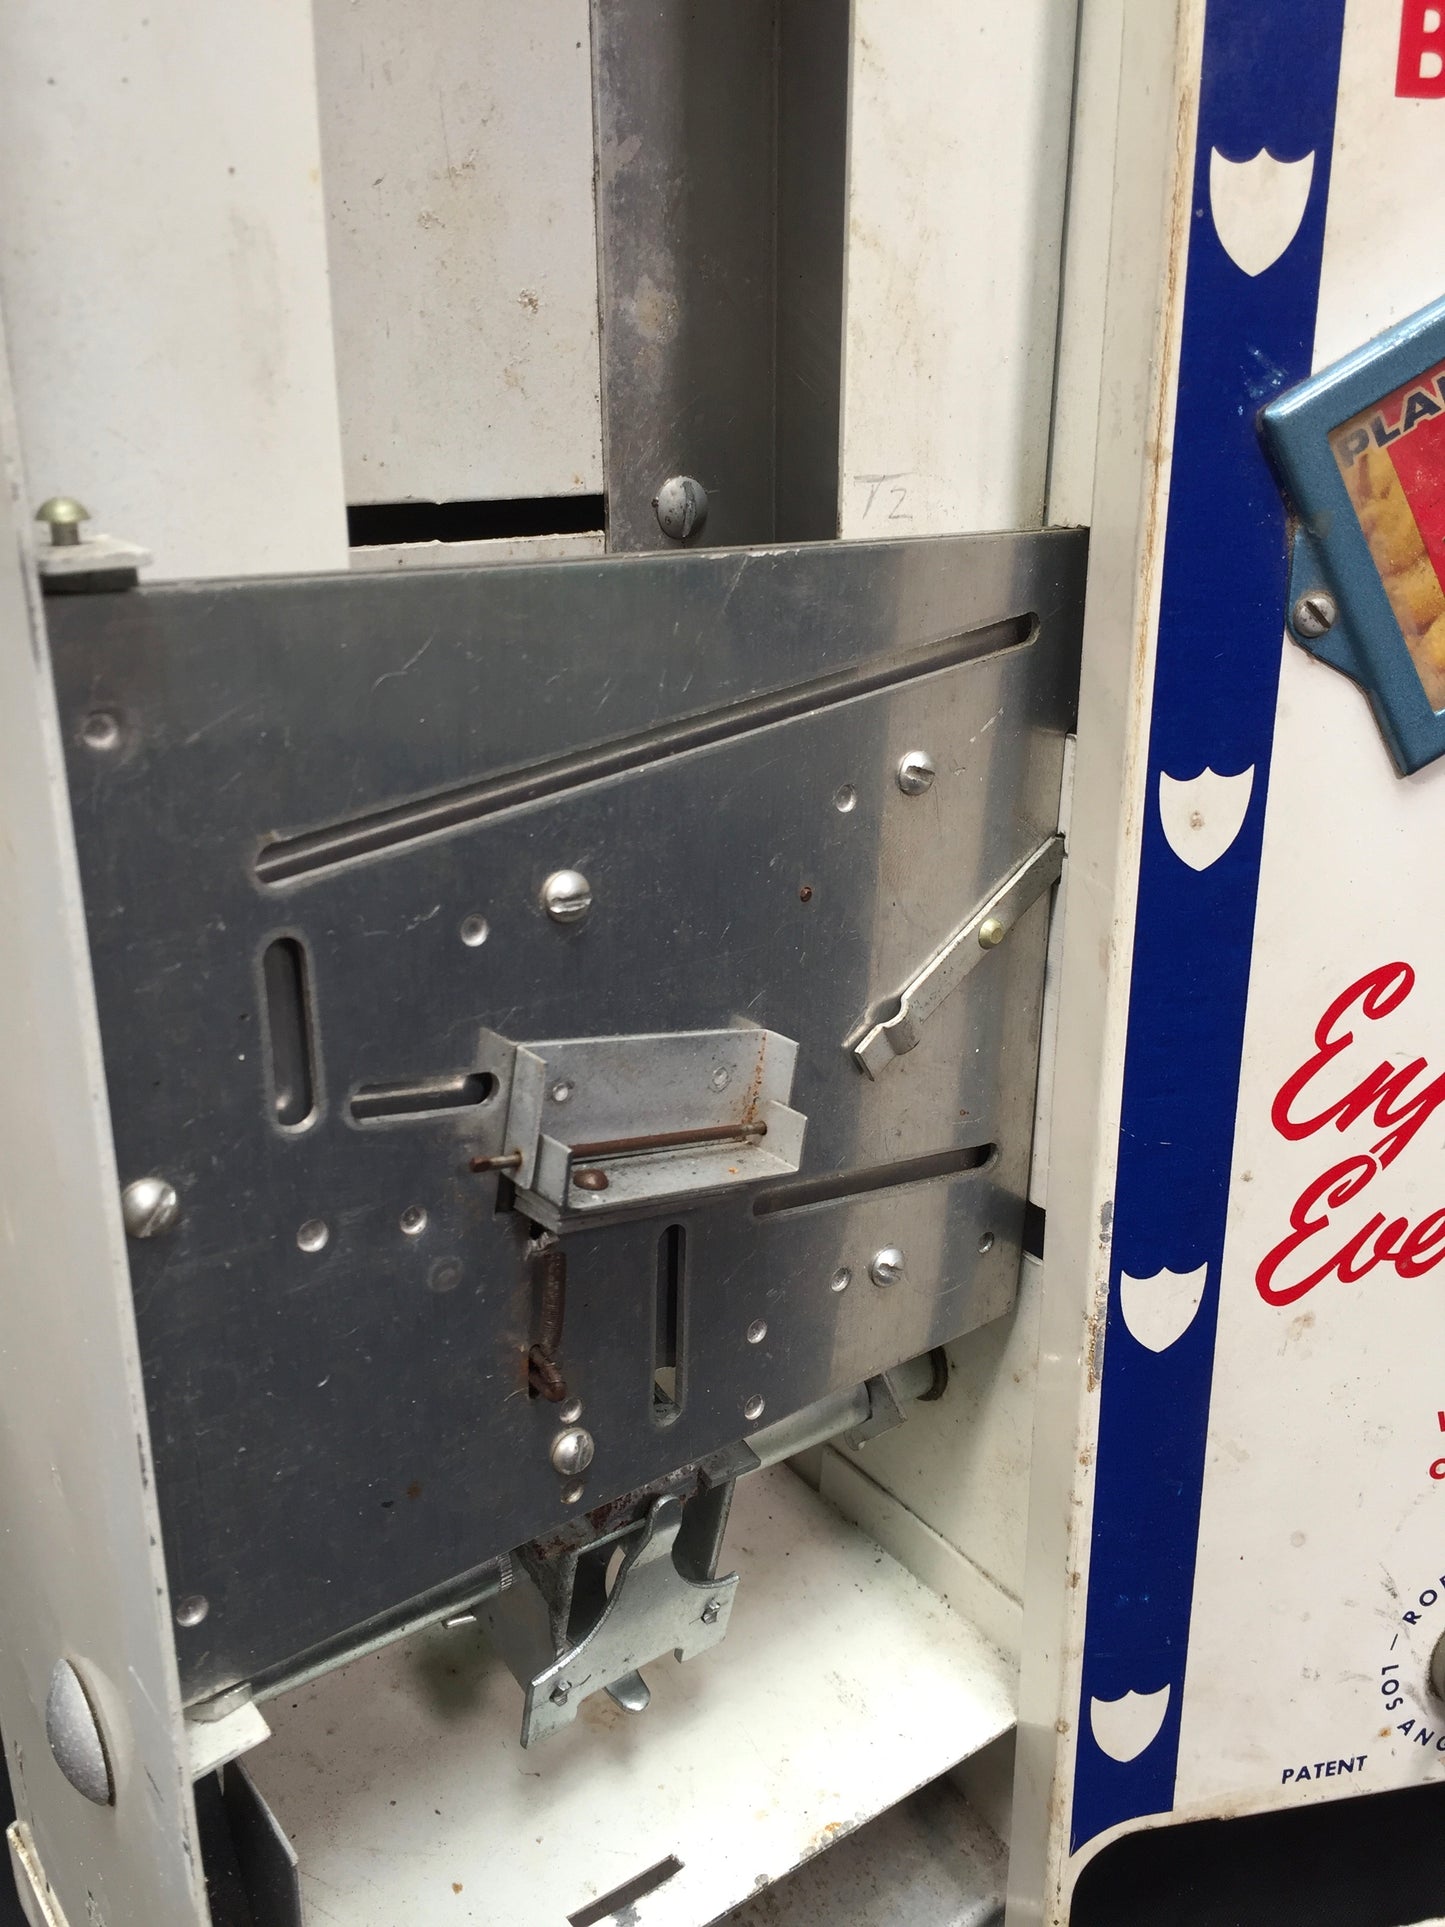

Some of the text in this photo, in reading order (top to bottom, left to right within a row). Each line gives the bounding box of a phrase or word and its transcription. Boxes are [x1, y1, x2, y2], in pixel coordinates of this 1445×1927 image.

[1337, 374, 1445, 469] PLA
[1381, 1664, 1404, 1711] LOS
[1281, 1755, 1368, 1785] PATENT
